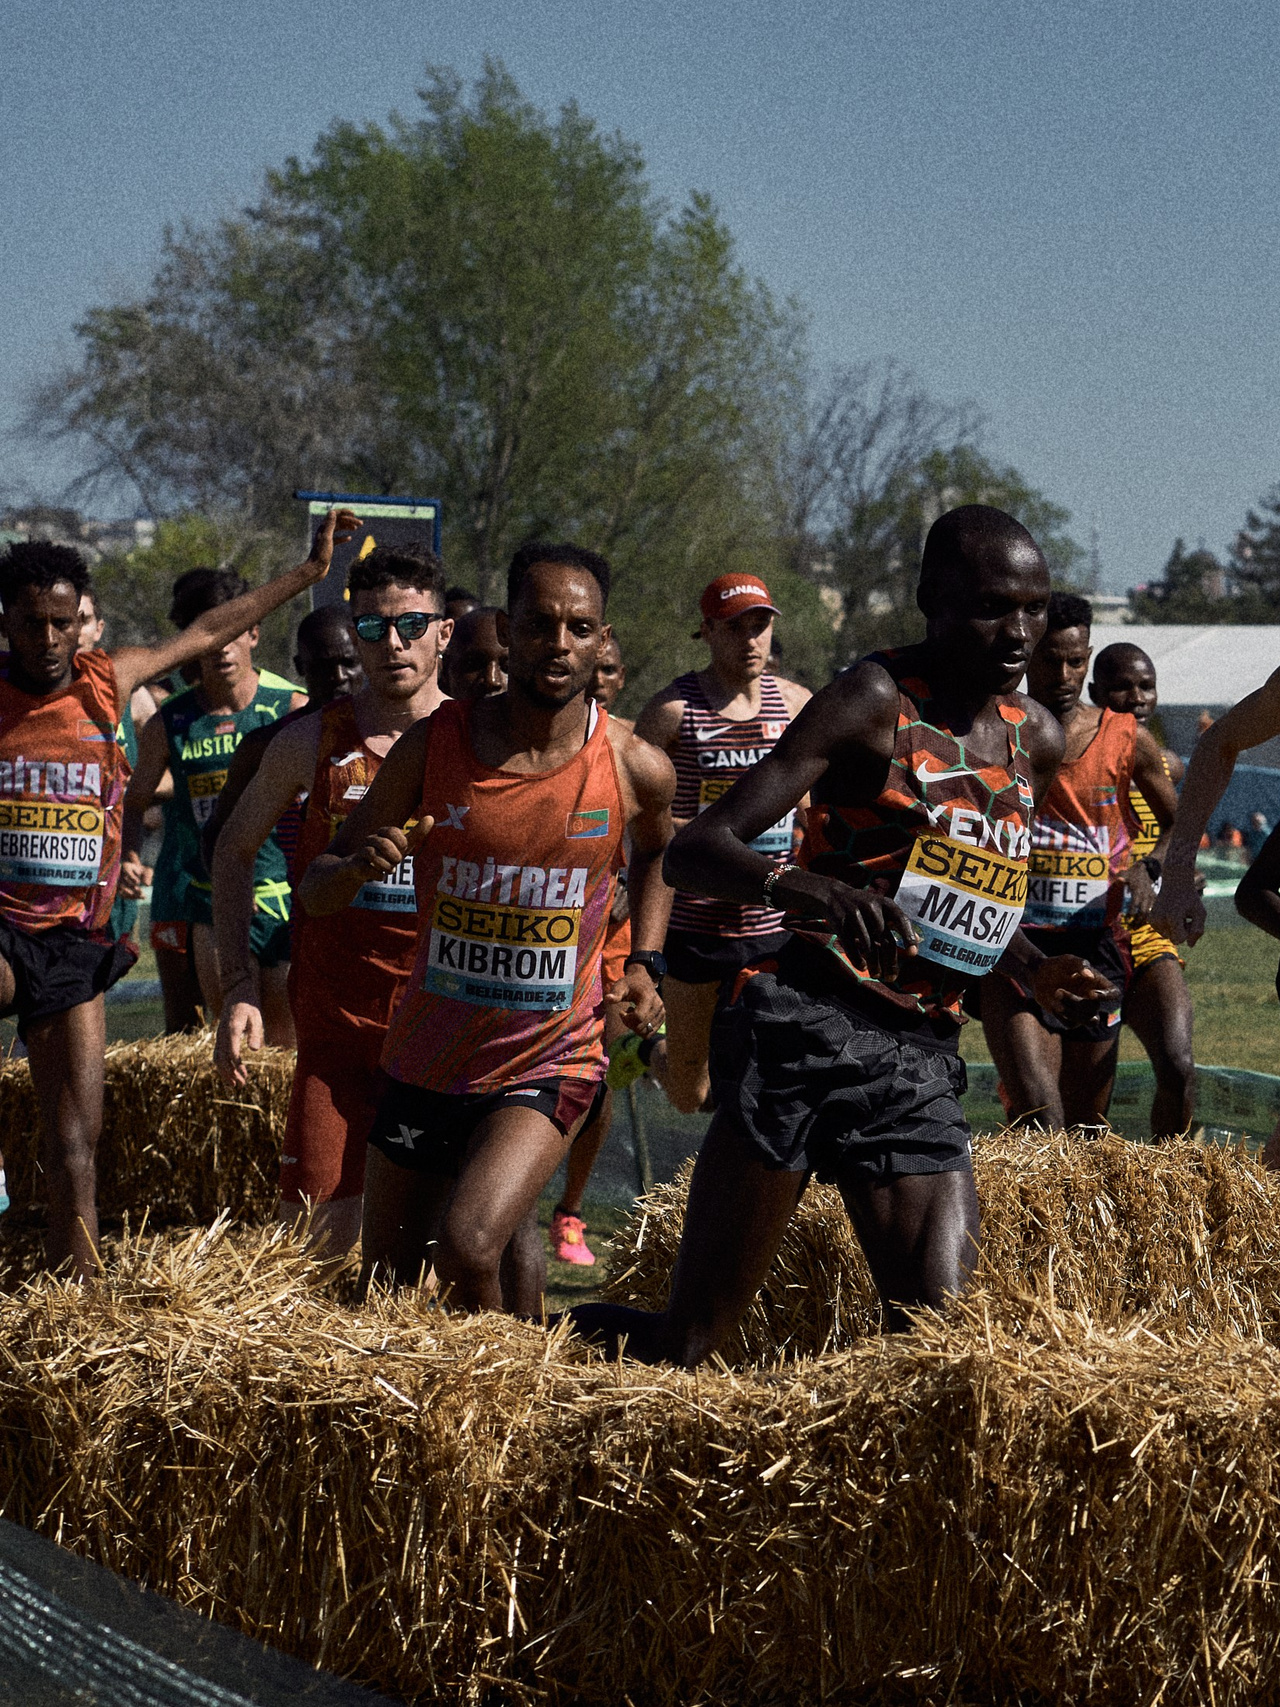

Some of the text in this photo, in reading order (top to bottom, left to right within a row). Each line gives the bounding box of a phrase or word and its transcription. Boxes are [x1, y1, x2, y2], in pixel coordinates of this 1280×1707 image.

[721, 585, 767, 599] CANADA
[0, 804, 100, 832] SEIKO
[923, 803, 1031, 858] KENYA
[0, 832, 97, 863] EBREKRSTOS
[17, 867, 93, 881] BELGRADE 24
[916, 840, 1028, 902] SEIKO
[1031, 853, 1106, 878] EIKO
[1027, 879, 1088, 904] KIFLE
[437, 900, 575, 943] SEIKO
[917, 884, 1015, 945] MASAI
[438, 935, 567, 979] KIBROM
[465, 984, 567, 1003] BELGRADE 24
